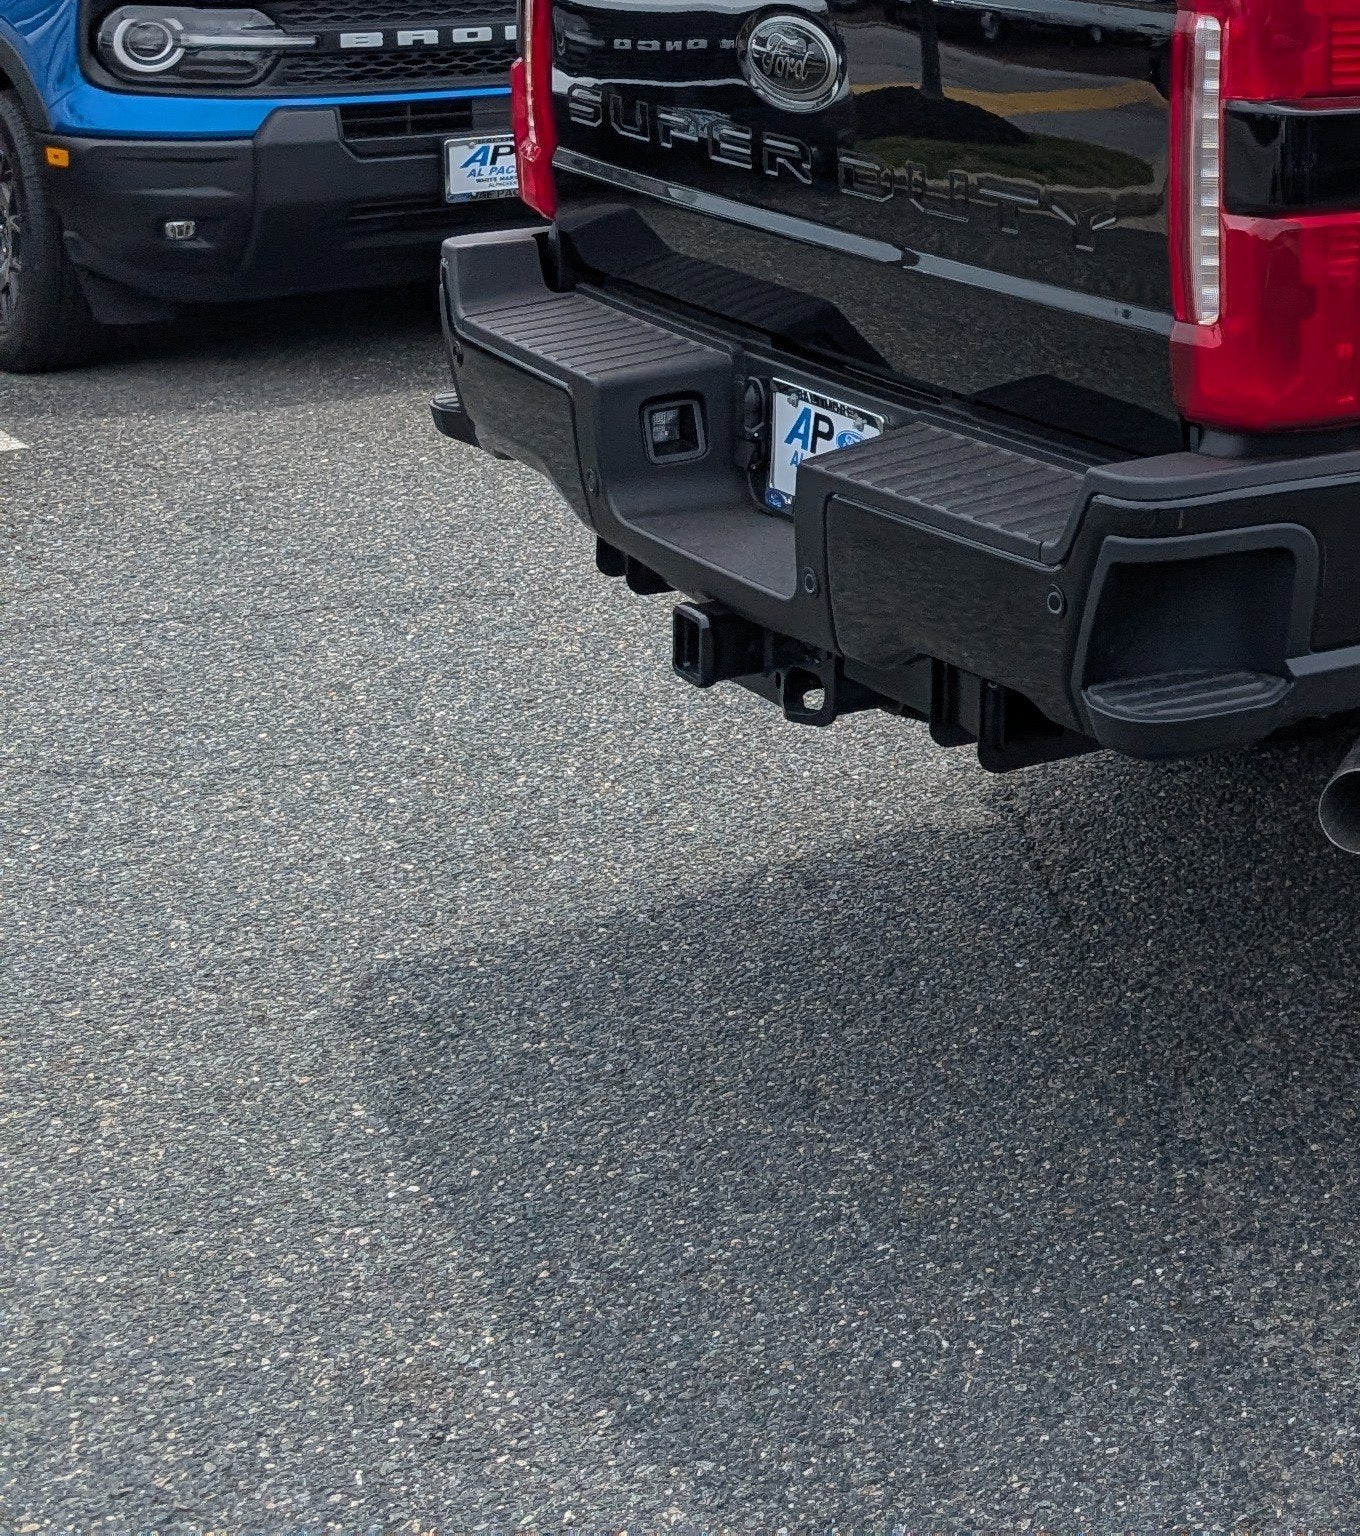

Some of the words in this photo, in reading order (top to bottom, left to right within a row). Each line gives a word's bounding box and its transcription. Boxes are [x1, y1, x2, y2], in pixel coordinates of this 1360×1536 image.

[339, 25, 518, 49] BRO
[761, 32, 815, 80] Ford
[467, 167, 485, 179] AL
[488, 165, 518, 176] PAC
[567, 83, 813, 185] SUPER
[837, 147, 1118, 252] DUTY
[783, 406, 835, 454] AP
